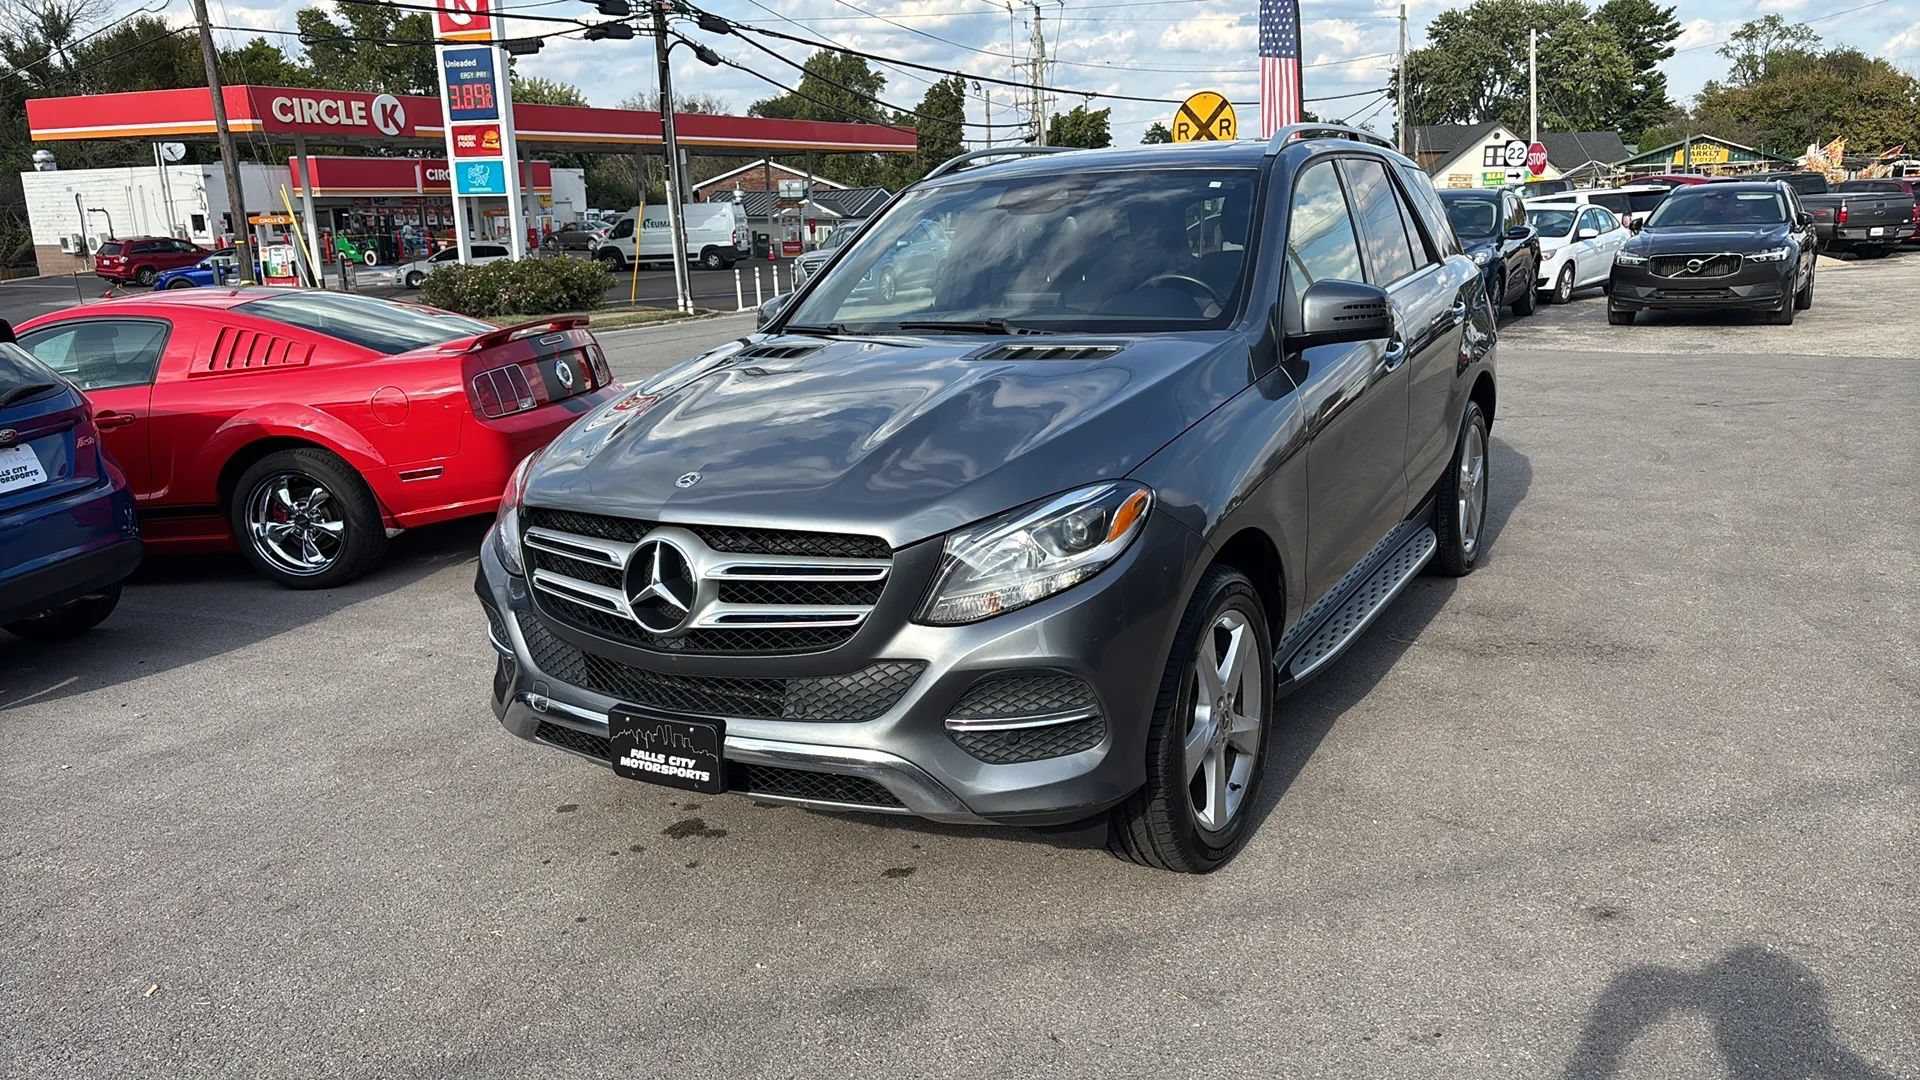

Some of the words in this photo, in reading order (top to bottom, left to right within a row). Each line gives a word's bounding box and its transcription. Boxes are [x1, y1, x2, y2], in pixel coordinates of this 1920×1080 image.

[445, 58, 477, 68] Unleaded
[272, 96, 368, 125] CIRCLE
[376, 100, 405, 133] K
[1178, 122, 1190, 141] R
[1219, 118, 1231, 136] R
[1507, 147, 1525, 160] 22
[1528, 152, 1546, 166] STOP
[426, 168, 450, 181] CIRC
[643, 218, 671, 230] NEUMA
[1, 469, 39, 484] ORSPORTS
[12, 465, 28, 475] CITY
[630, 748, 666, 764] FALLS
[668, 755, 696, 769] CITY
[620, 756, 711, 782] MOTORSPORTS
